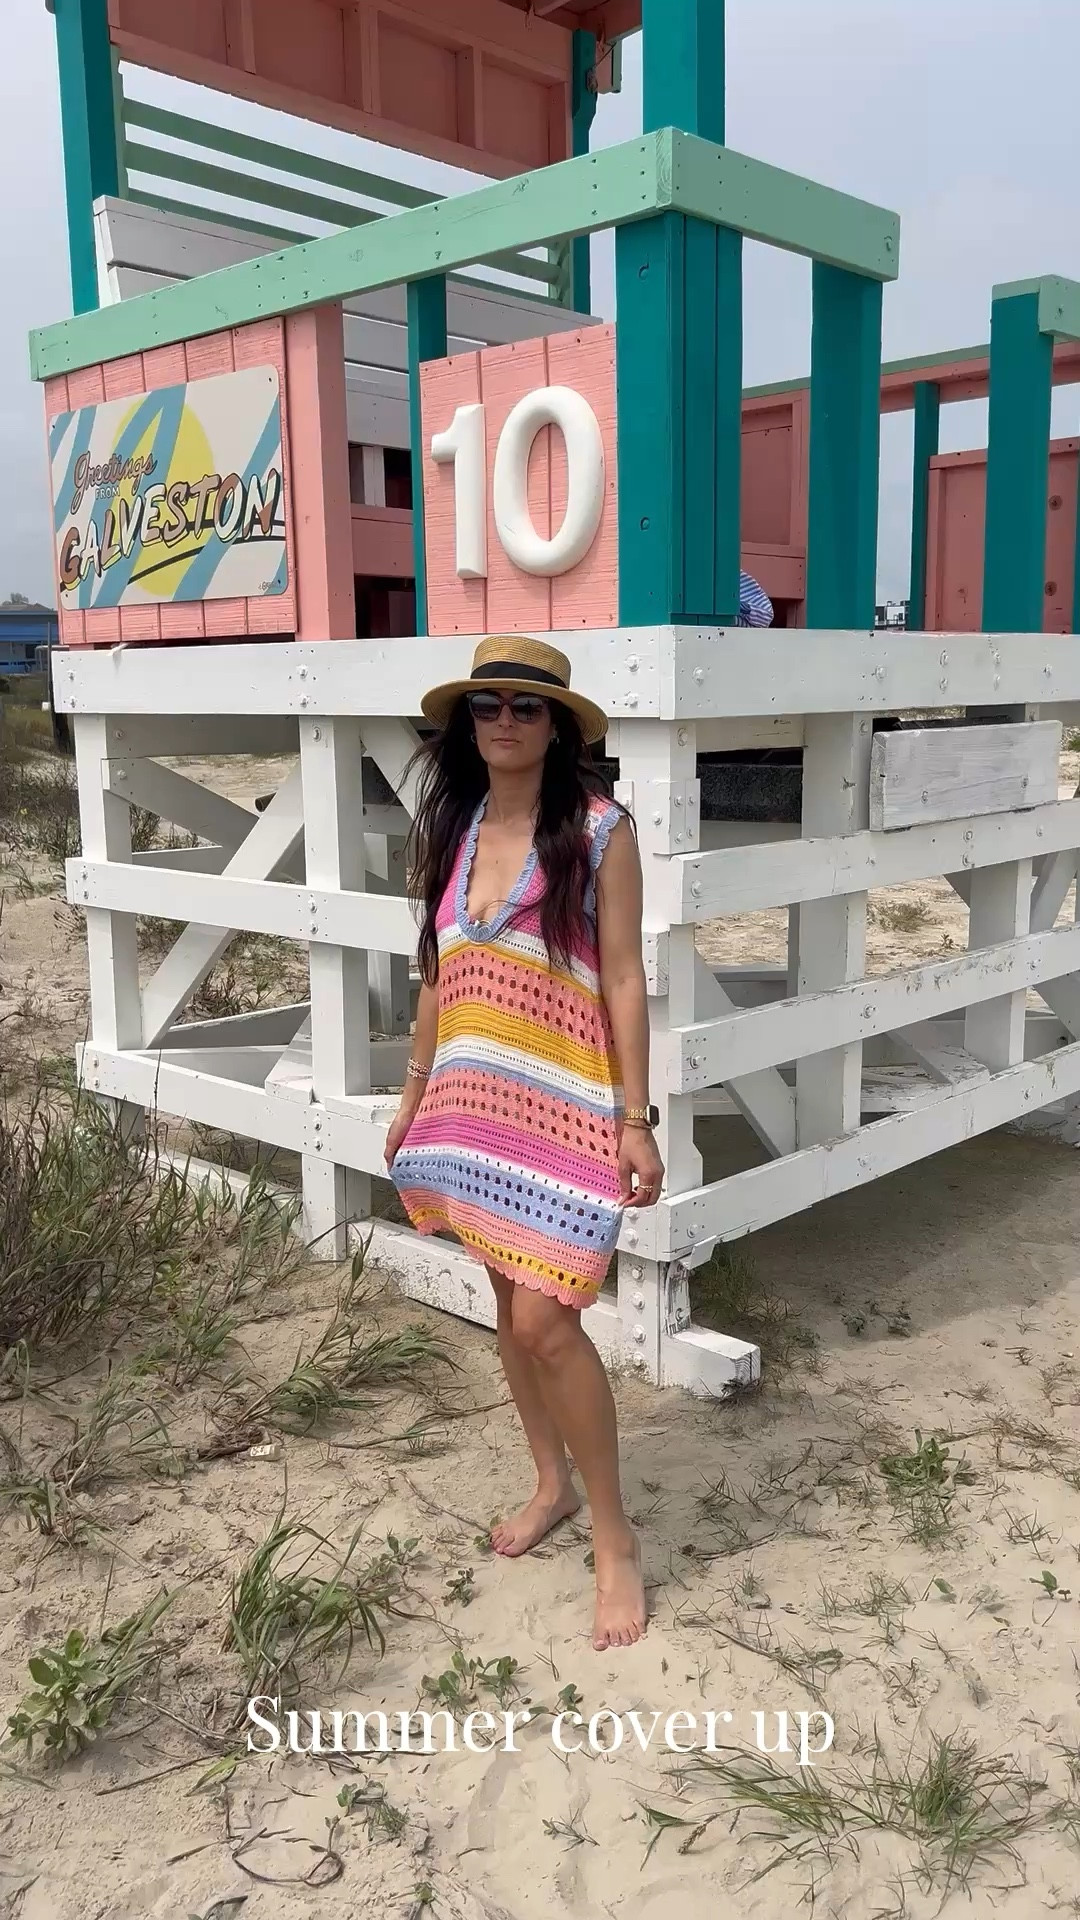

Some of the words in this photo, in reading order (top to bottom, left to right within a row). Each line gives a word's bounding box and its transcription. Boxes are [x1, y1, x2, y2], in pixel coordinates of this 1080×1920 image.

[60, 467, 281, 591] GALVESTON
[71, 451, 157, 515] Greetings
[95, 485, 120, 500] FROM
[431, 385, 605, 579] 10
